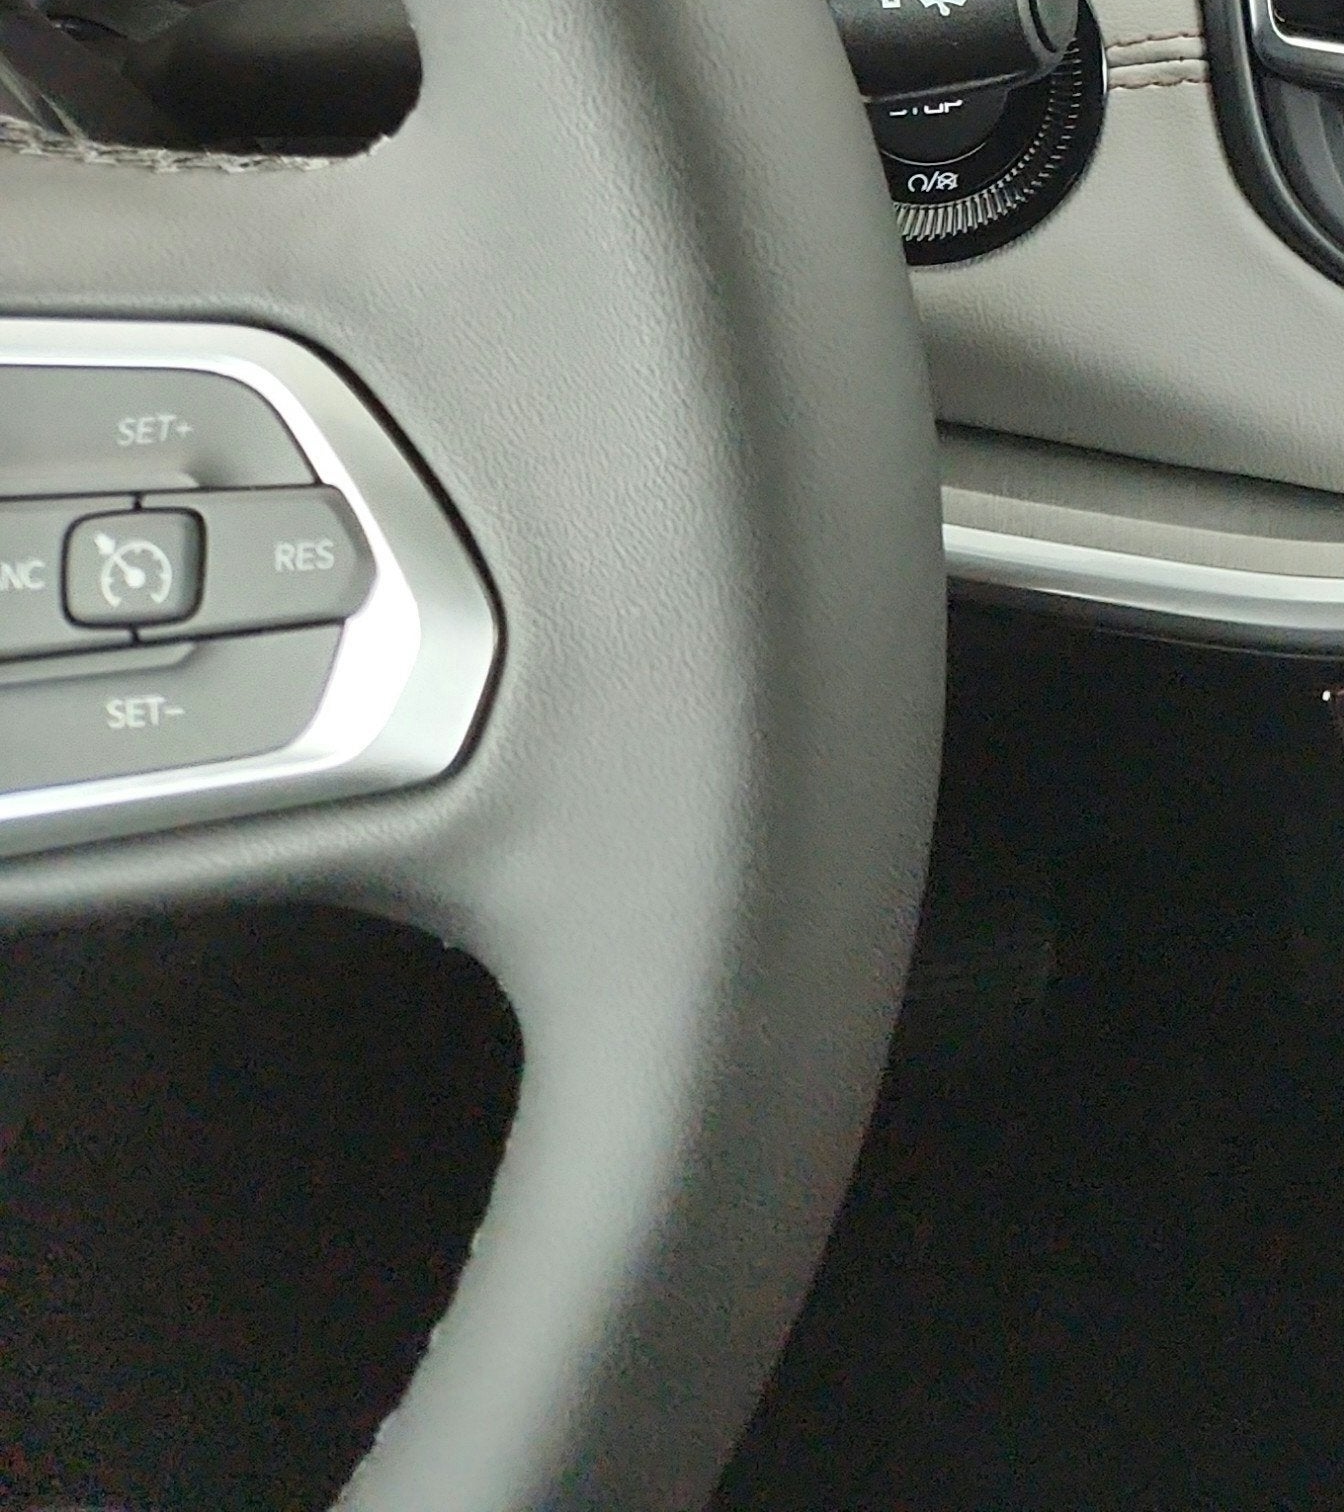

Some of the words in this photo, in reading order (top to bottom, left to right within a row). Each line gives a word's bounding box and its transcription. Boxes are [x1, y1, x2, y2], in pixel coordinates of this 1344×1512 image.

[117, 413, 194, 447] SET+
[274, 538, 335, 573] RES
[106, 695, 185, 730] SET-
